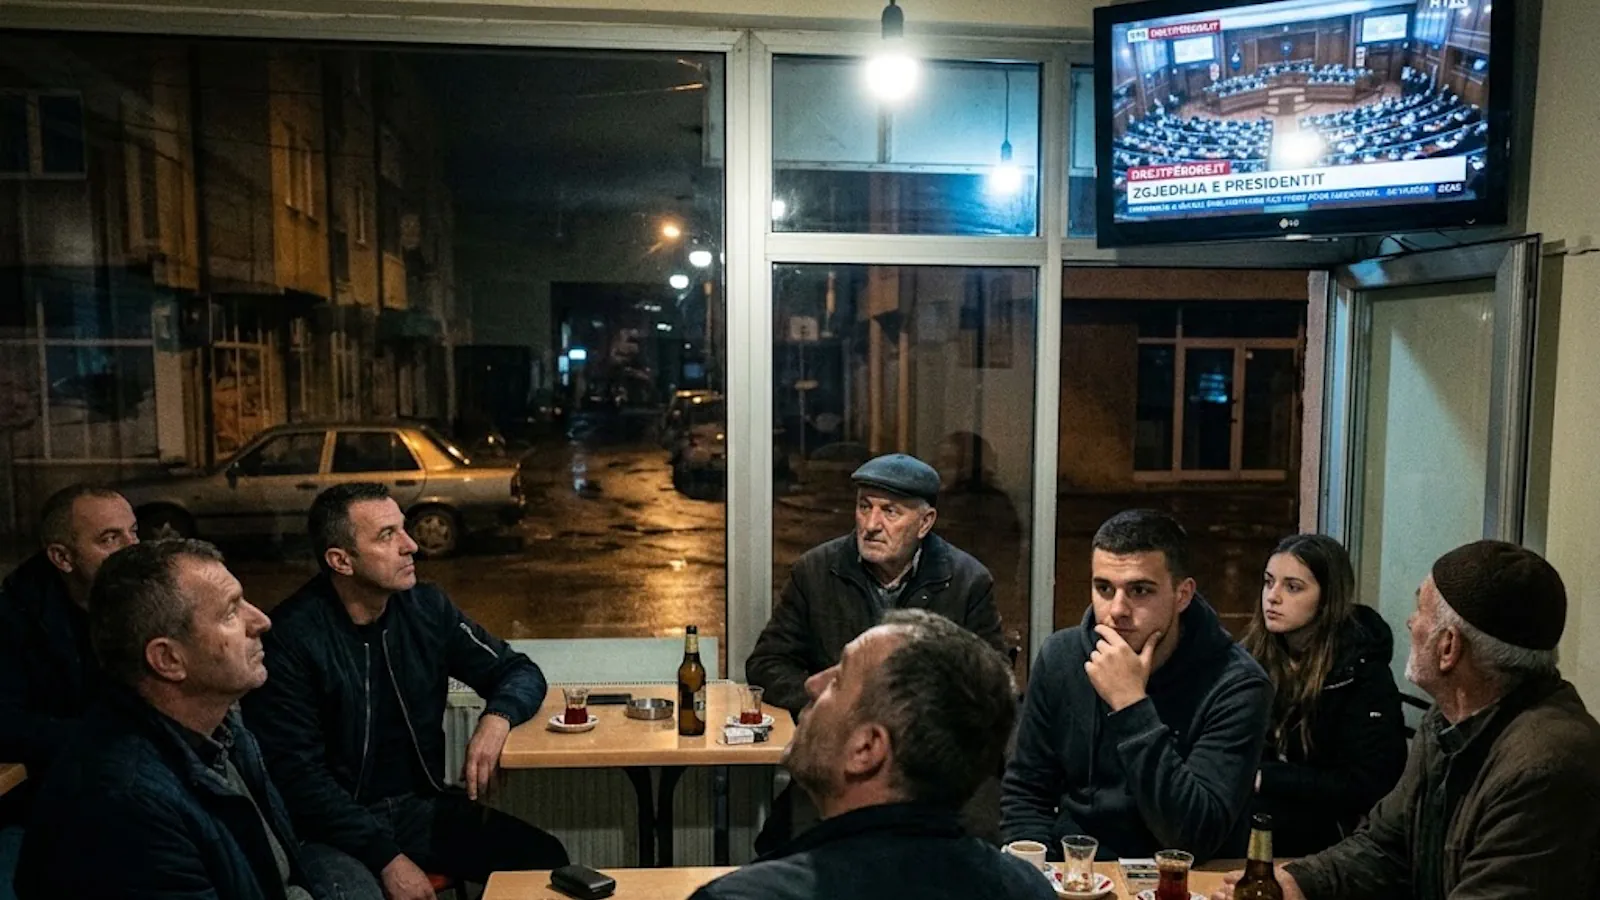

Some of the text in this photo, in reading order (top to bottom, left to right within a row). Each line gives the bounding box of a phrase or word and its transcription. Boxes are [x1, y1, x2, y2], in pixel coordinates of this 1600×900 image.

[1133, 173, 1325, 199] ZGJEDHJA E PRESIDENTIT
